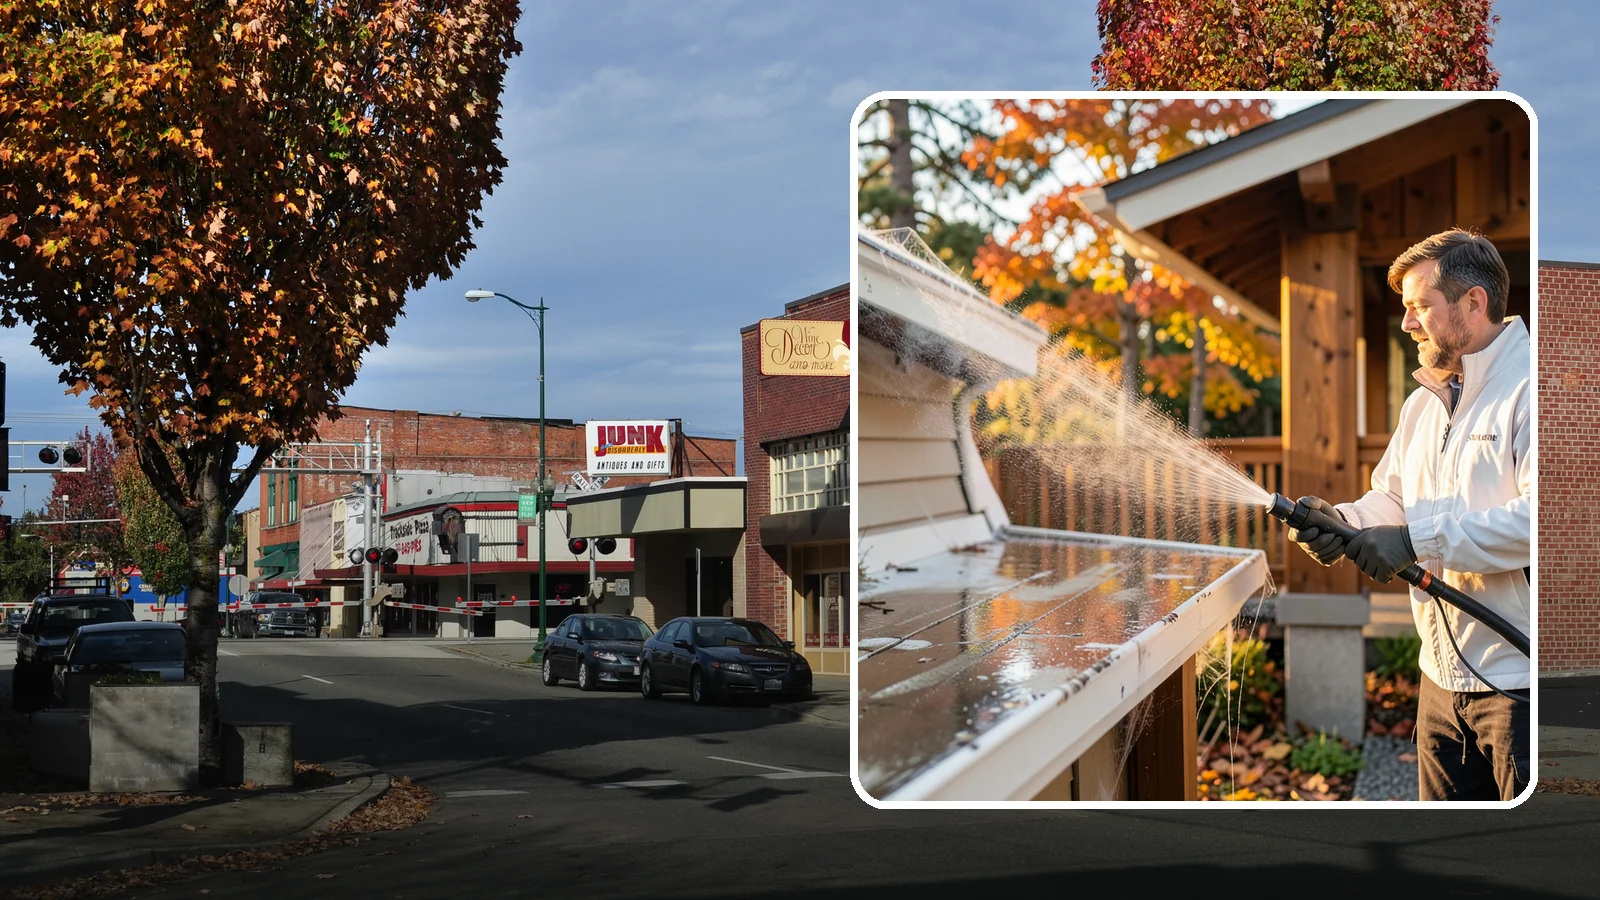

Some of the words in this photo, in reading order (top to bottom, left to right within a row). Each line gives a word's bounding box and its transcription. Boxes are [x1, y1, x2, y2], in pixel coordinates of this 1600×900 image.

[596, 425, 664, 457] JUNK
[607, 446, 646, 454] DISORDERLY
[597, 461, 628, 470] ANTIQUES
[631, 461, 644, 469] AND
[647, 460, 665, 469] GIFTS
[573, 473, 589, 491] RAIL
[588, 476, 608, 492] SING
[352, 499, 365, 511] CRO
[415, 519, 429, 535] Pizza
